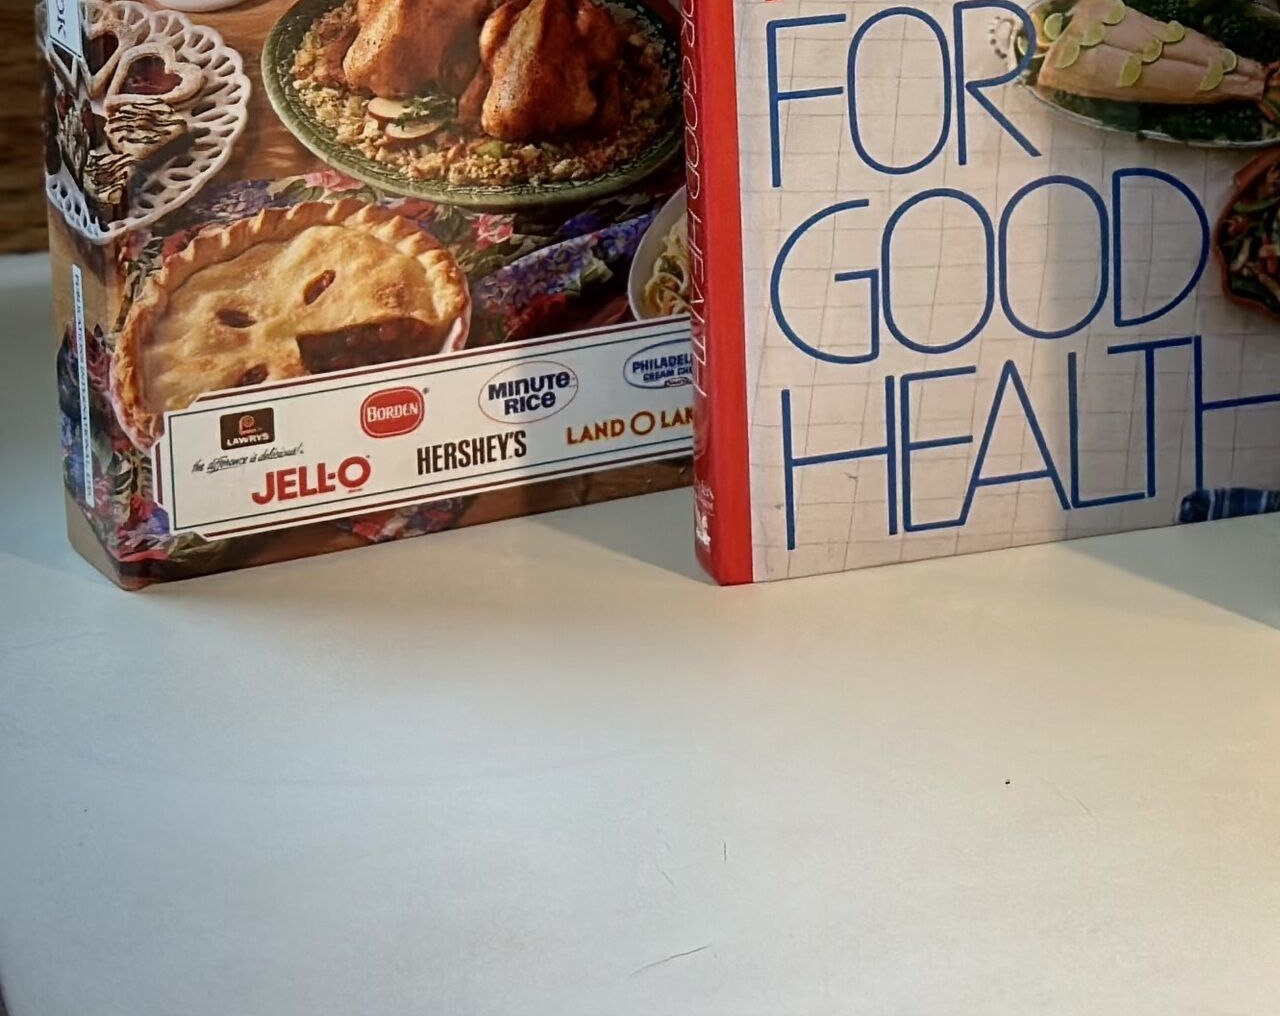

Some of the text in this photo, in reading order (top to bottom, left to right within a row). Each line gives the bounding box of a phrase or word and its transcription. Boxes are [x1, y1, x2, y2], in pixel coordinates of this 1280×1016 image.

[766, 0, 1041, 188] FOR
[770, 168, 1210, 364] GOOD
[632, 353, 692, 373] PHILADEL
[567, 406, 693, 445] LAND O LAK
[417, 430, 527, 476] HERSHEY'S
[251, 456, 371, 505] JELL-O
